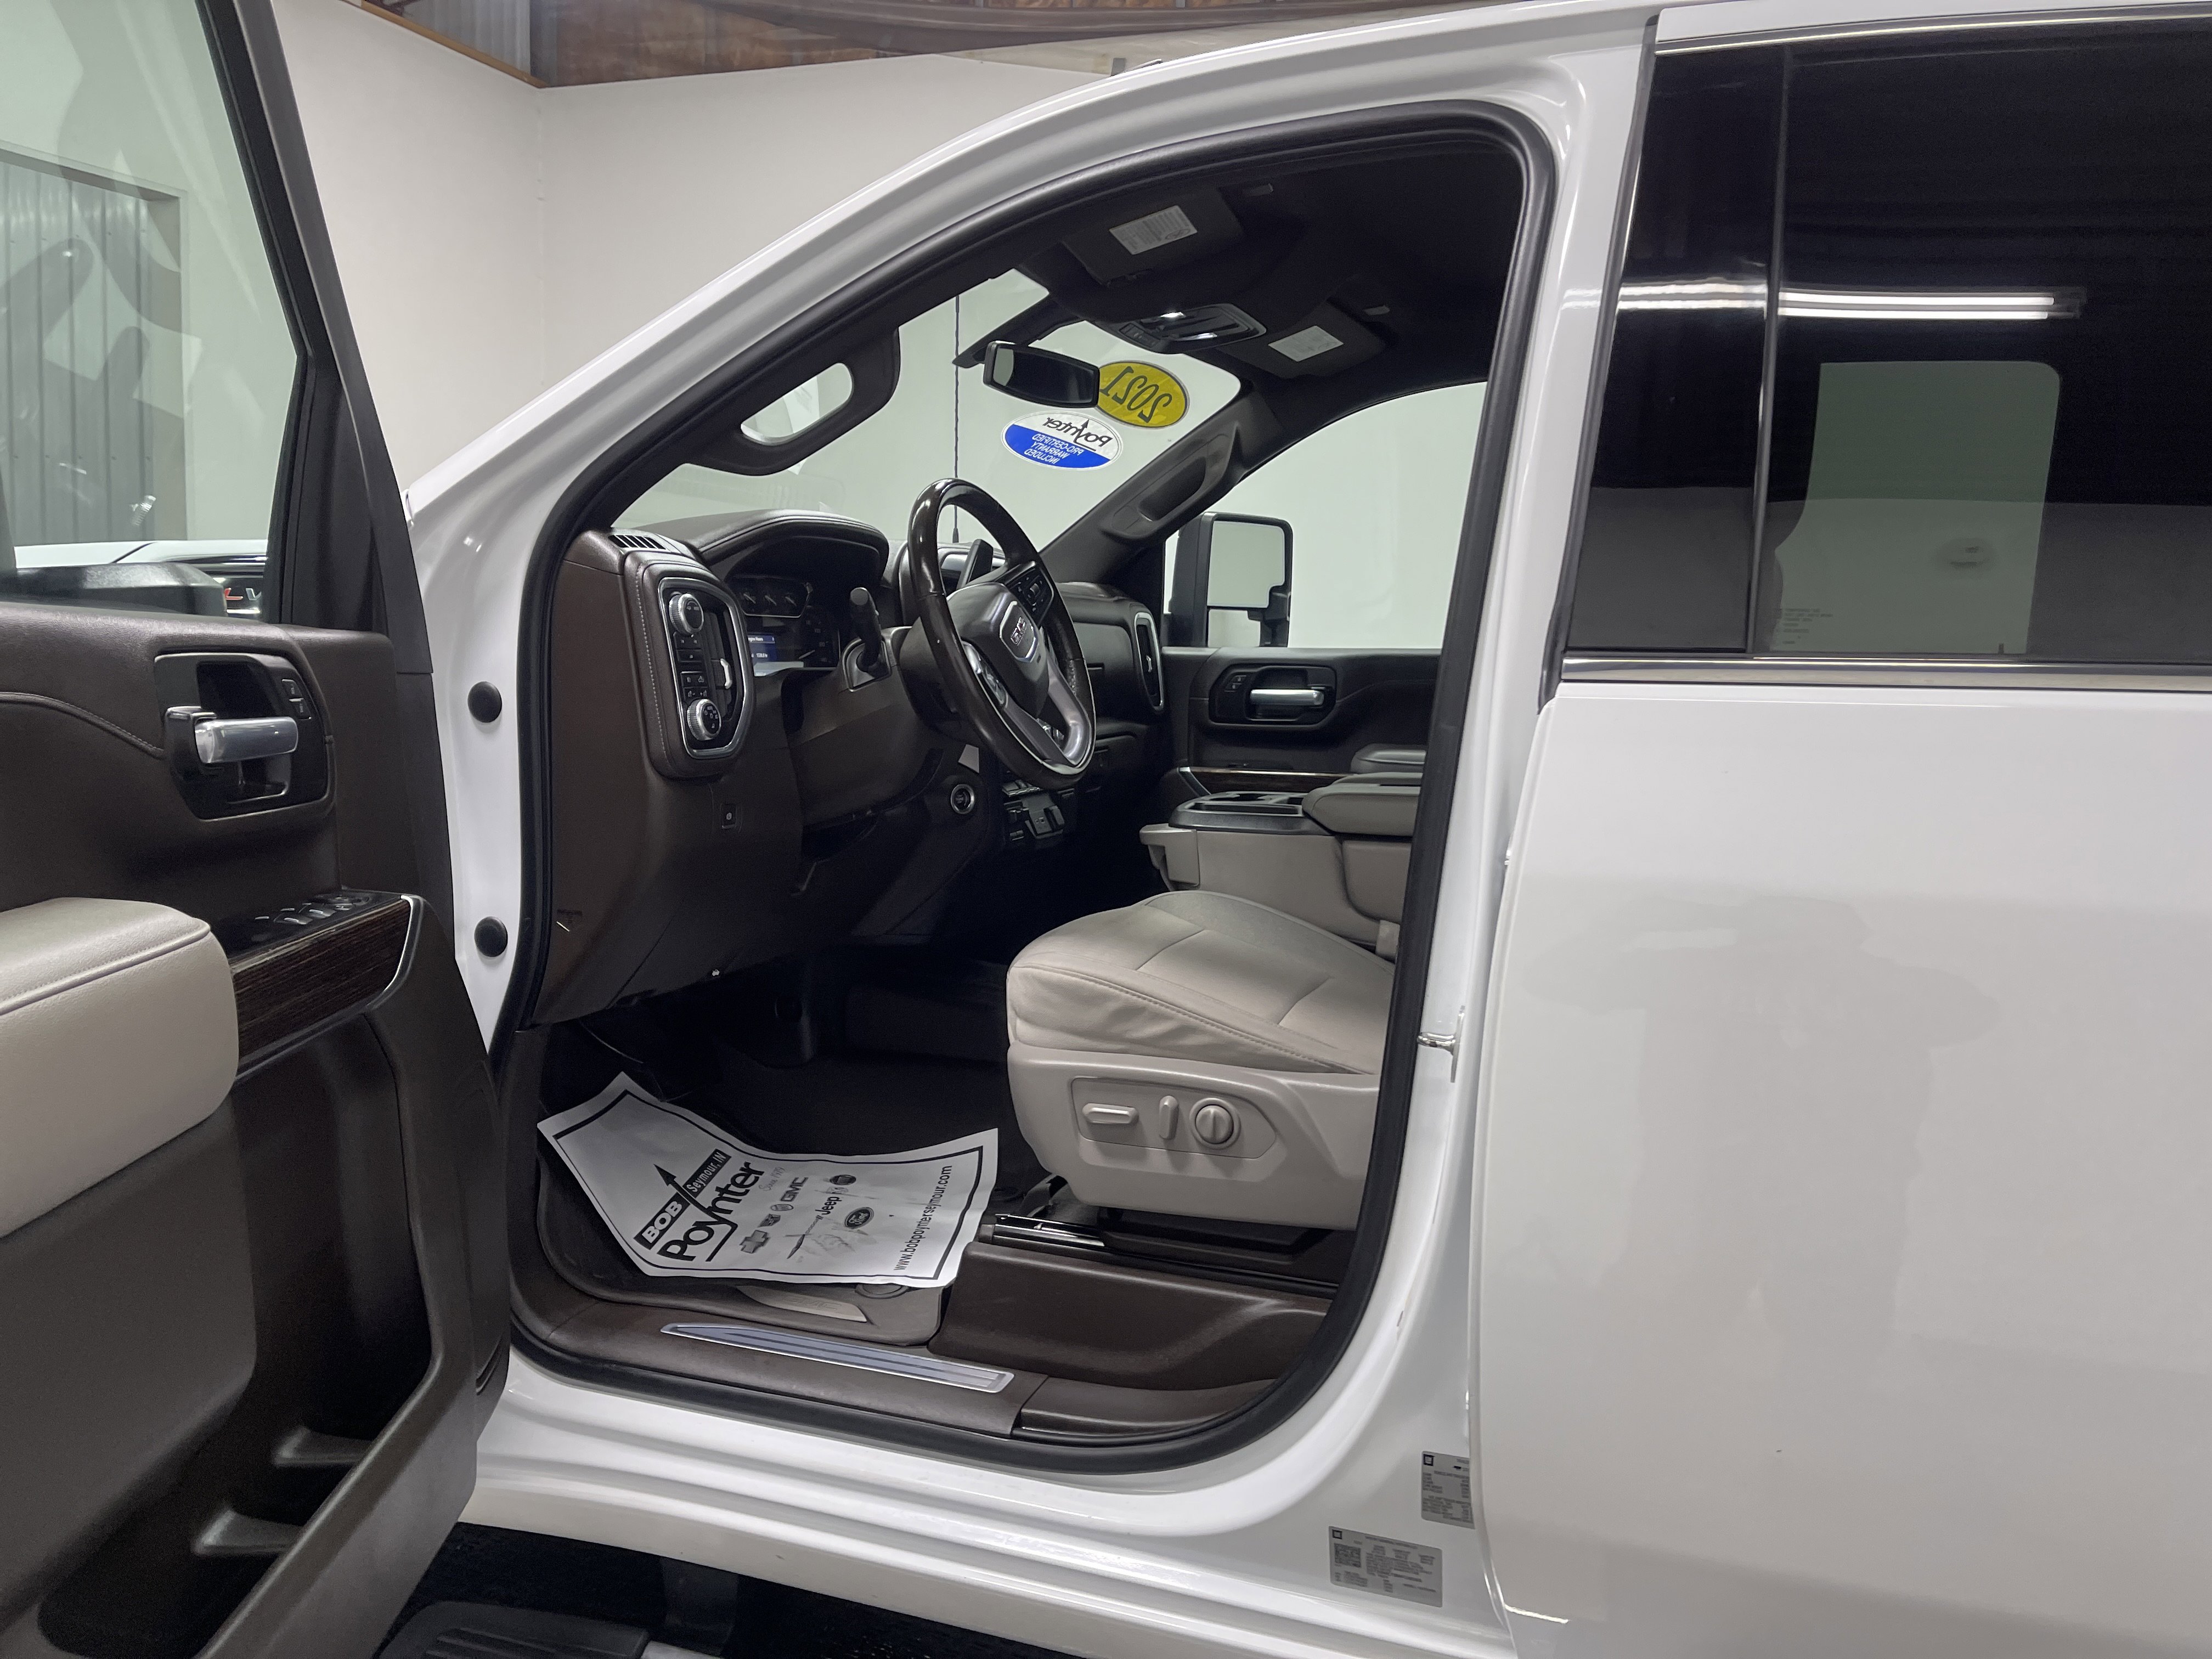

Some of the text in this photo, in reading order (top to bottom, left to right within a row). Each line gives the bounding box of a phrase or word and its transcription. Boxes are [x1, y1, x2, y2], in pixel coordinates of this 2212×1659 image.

[641, 1152, 726, 1244] BOB Seymour, IN
[657, 1161, 764, 1261] Poynter
[780, 1176, 809, 1201] GMC
[815, 1197, 842, 1215] Jeep
[849, 1212, 869, 1225] Ford
[894, 1165, 952, 1271] www.bobpoynterseymour.com
